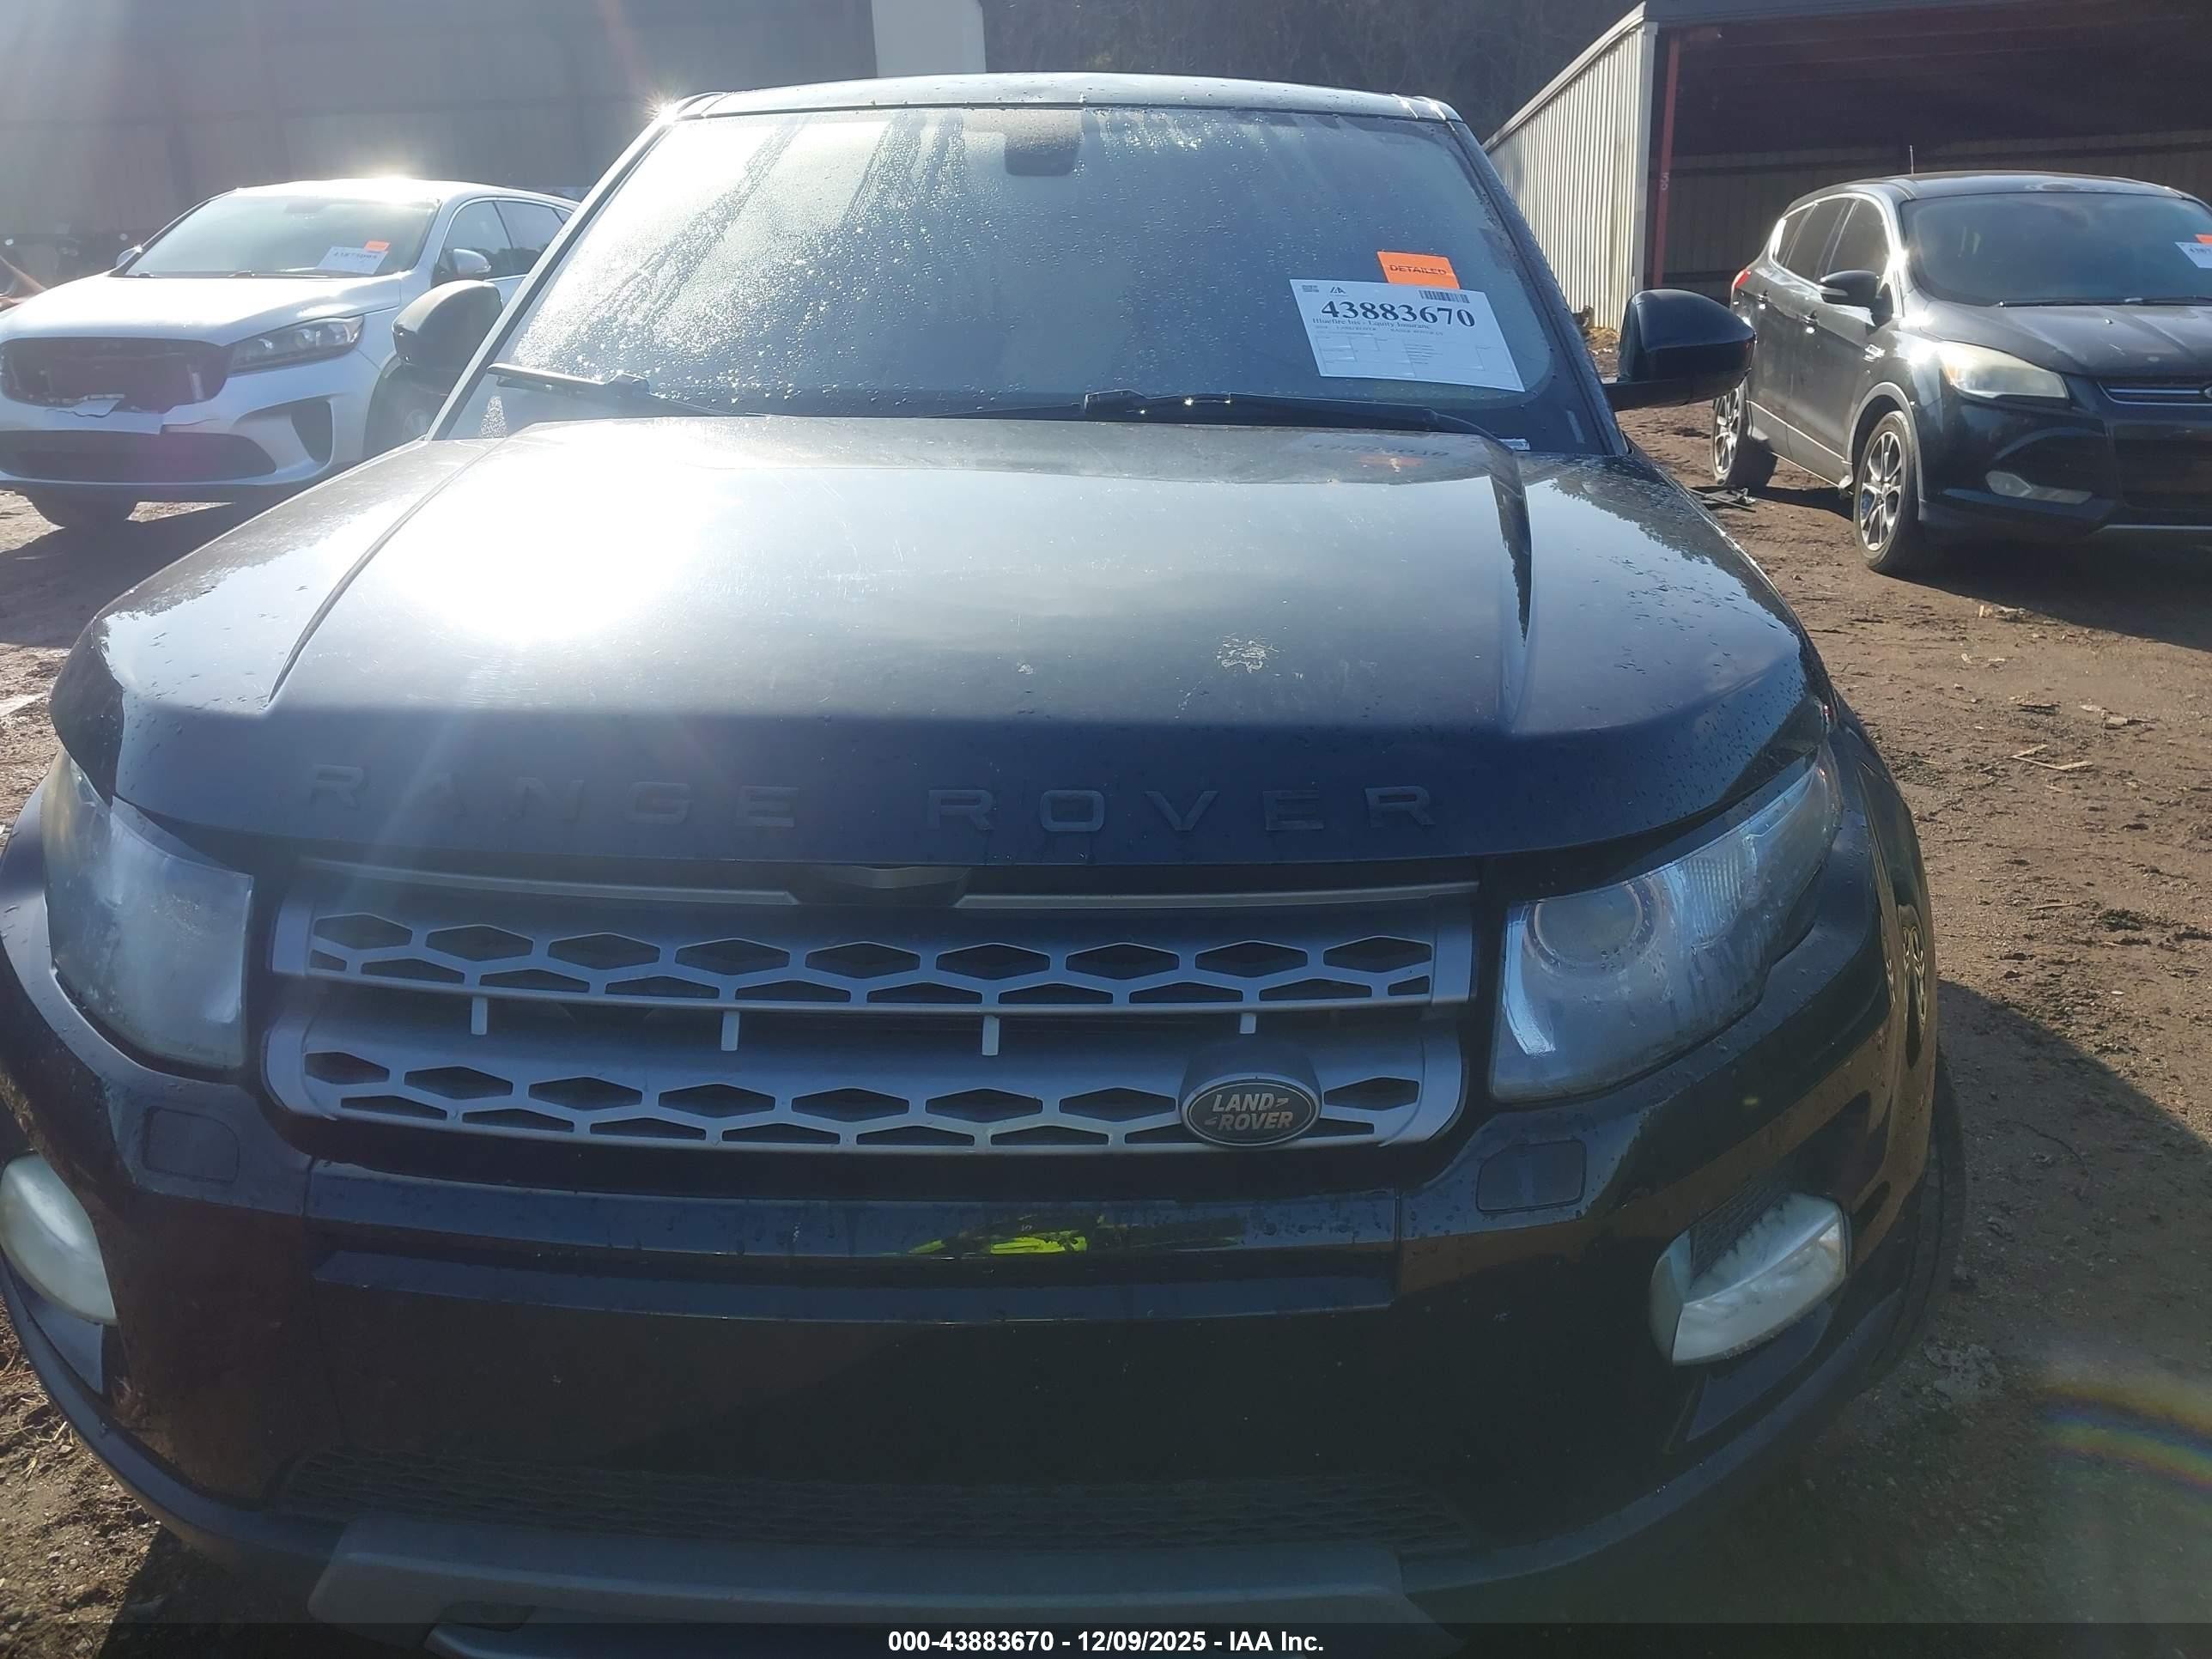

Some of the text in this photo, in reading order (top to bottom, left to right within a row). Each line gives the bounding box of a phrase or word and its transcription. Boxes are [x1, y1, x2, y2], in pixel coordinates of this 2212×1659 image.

[1389, 264, 1447, 276] DETAILED
[1321, 301, 1475, 327] 43883670
[311, 763, 1437, 832] RANGE ROVER
[1212, 1093, 1274, 1113] LAND
[1218, 1111, 1294, 1131] ROVER
